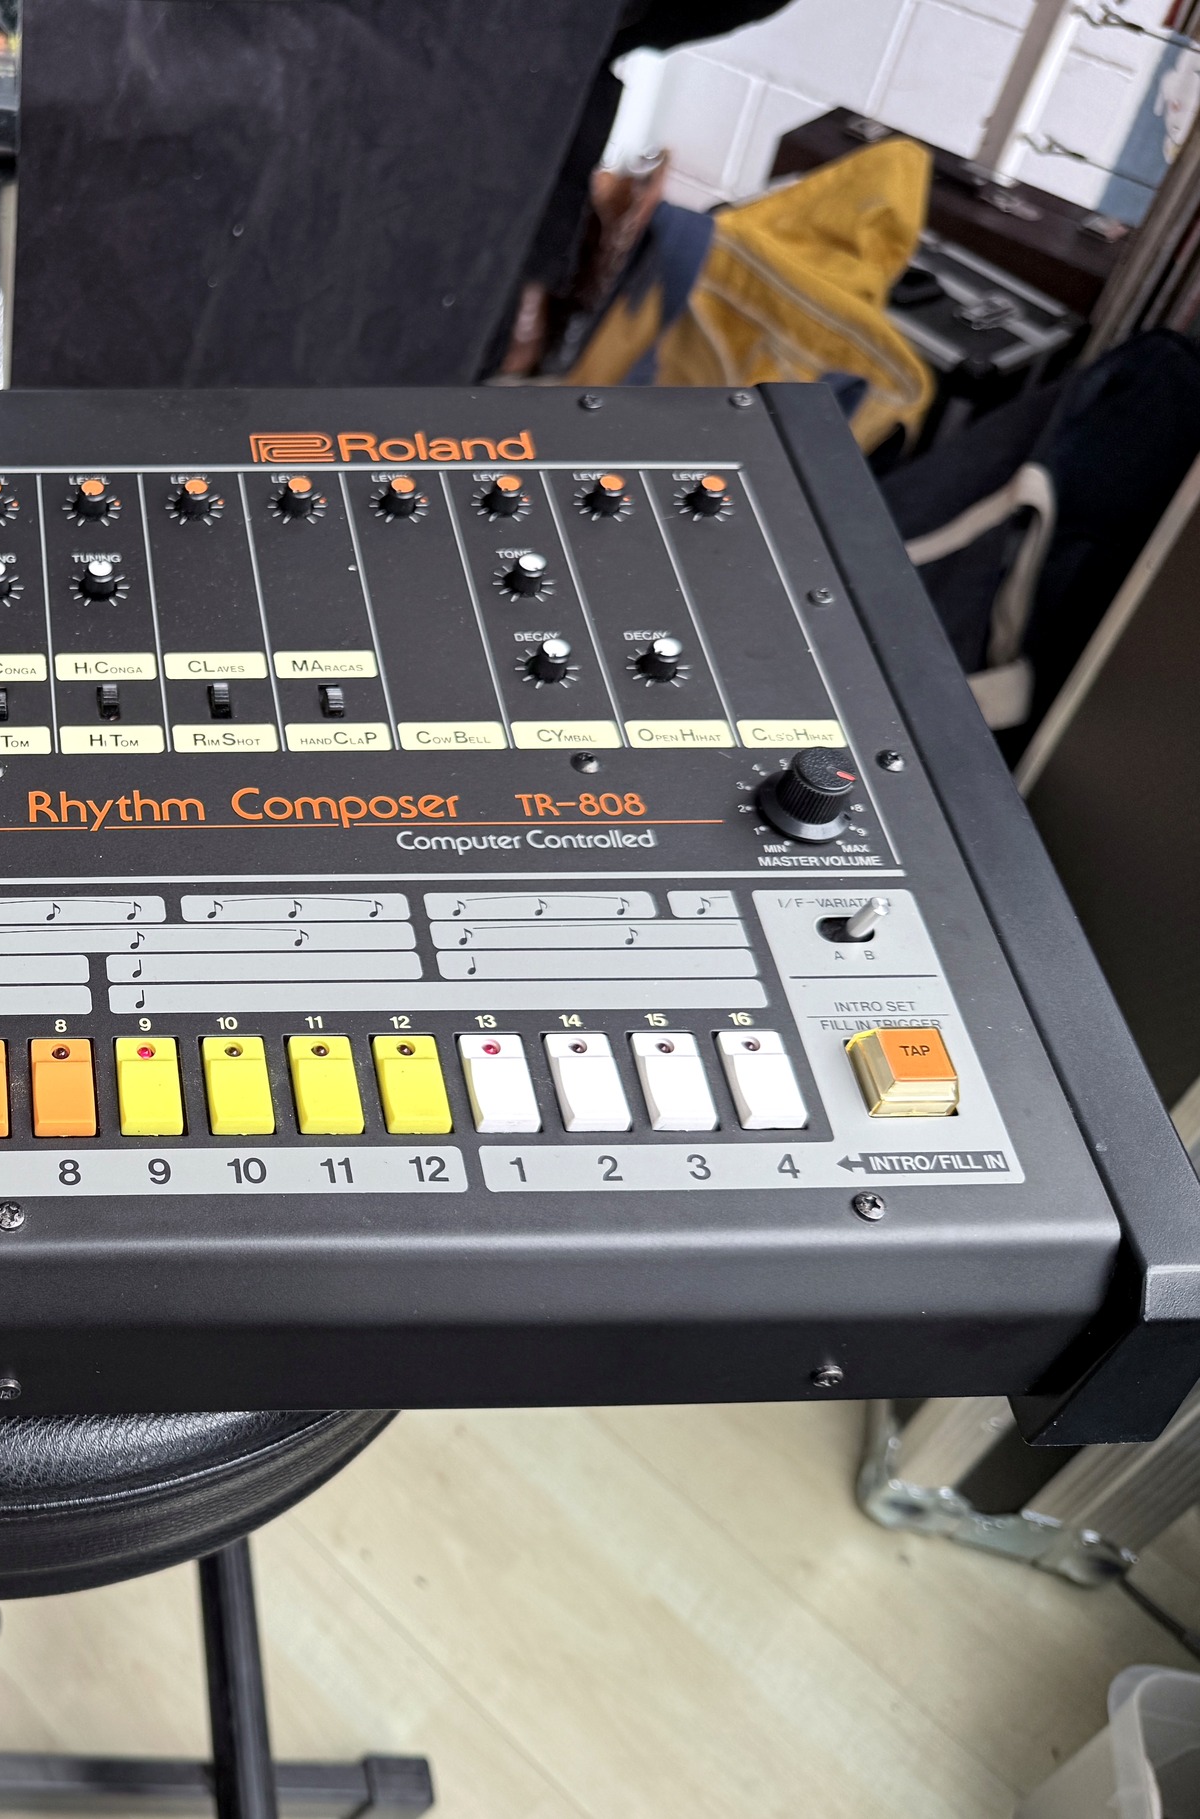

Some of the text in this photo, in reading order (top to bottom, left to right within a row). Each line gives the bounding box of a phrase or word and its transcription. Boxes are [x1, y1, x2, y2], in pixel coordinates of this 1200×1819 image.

[337, 431, 535, 462] Roland
[28, 787, 647, 832] Rhythm Composer TR-808
[396, 829, 657, 855] Computer Controlled
[763, 844, 787, 853] MIN
[841, 844, 870, 853] MAX
[758, 856, 883, 866] MASTER VOLUME
[834, 951, 845, 960] A
[864, 950, 875, 960] B
[834, 1001, 916, 1012] INTRO SET
[55, 1018, 68, 1033] 8
[138, 1017, 152, 1032] 9
[216, 1016, 238, 1031] 10
[304, 1015, 324, 1030] 11
[389, 1015, 412, 1030] 12
[474, 1014, 498, 1029] 13
[558, 1013, 584, 1028] 14
[643, 1012, 668, 1027] 15
[728, 1012, 753, 1026] 16
[820, 1020, 853, 1030] FILL
[855, 1020, 870, 1030] IN
[899, 1045, 931, 1056] TAP
[408, 1156, 450, 1183] 12
[509, 1157, 527, 1182] 1
[598, 1155, 623, 1182] 2
[686, 1154, 711, 1180] 3
[777, 1154, 800, 1178] 4
[869, 1154, 1005, 1171] INTRO/FILL IN
[58, 1160, 82, 1186] 8
[147, 1158, 172, 1185] 9
[226, 1158, 267, 1184] 10
[319, 1158, 354, 1184] 11
